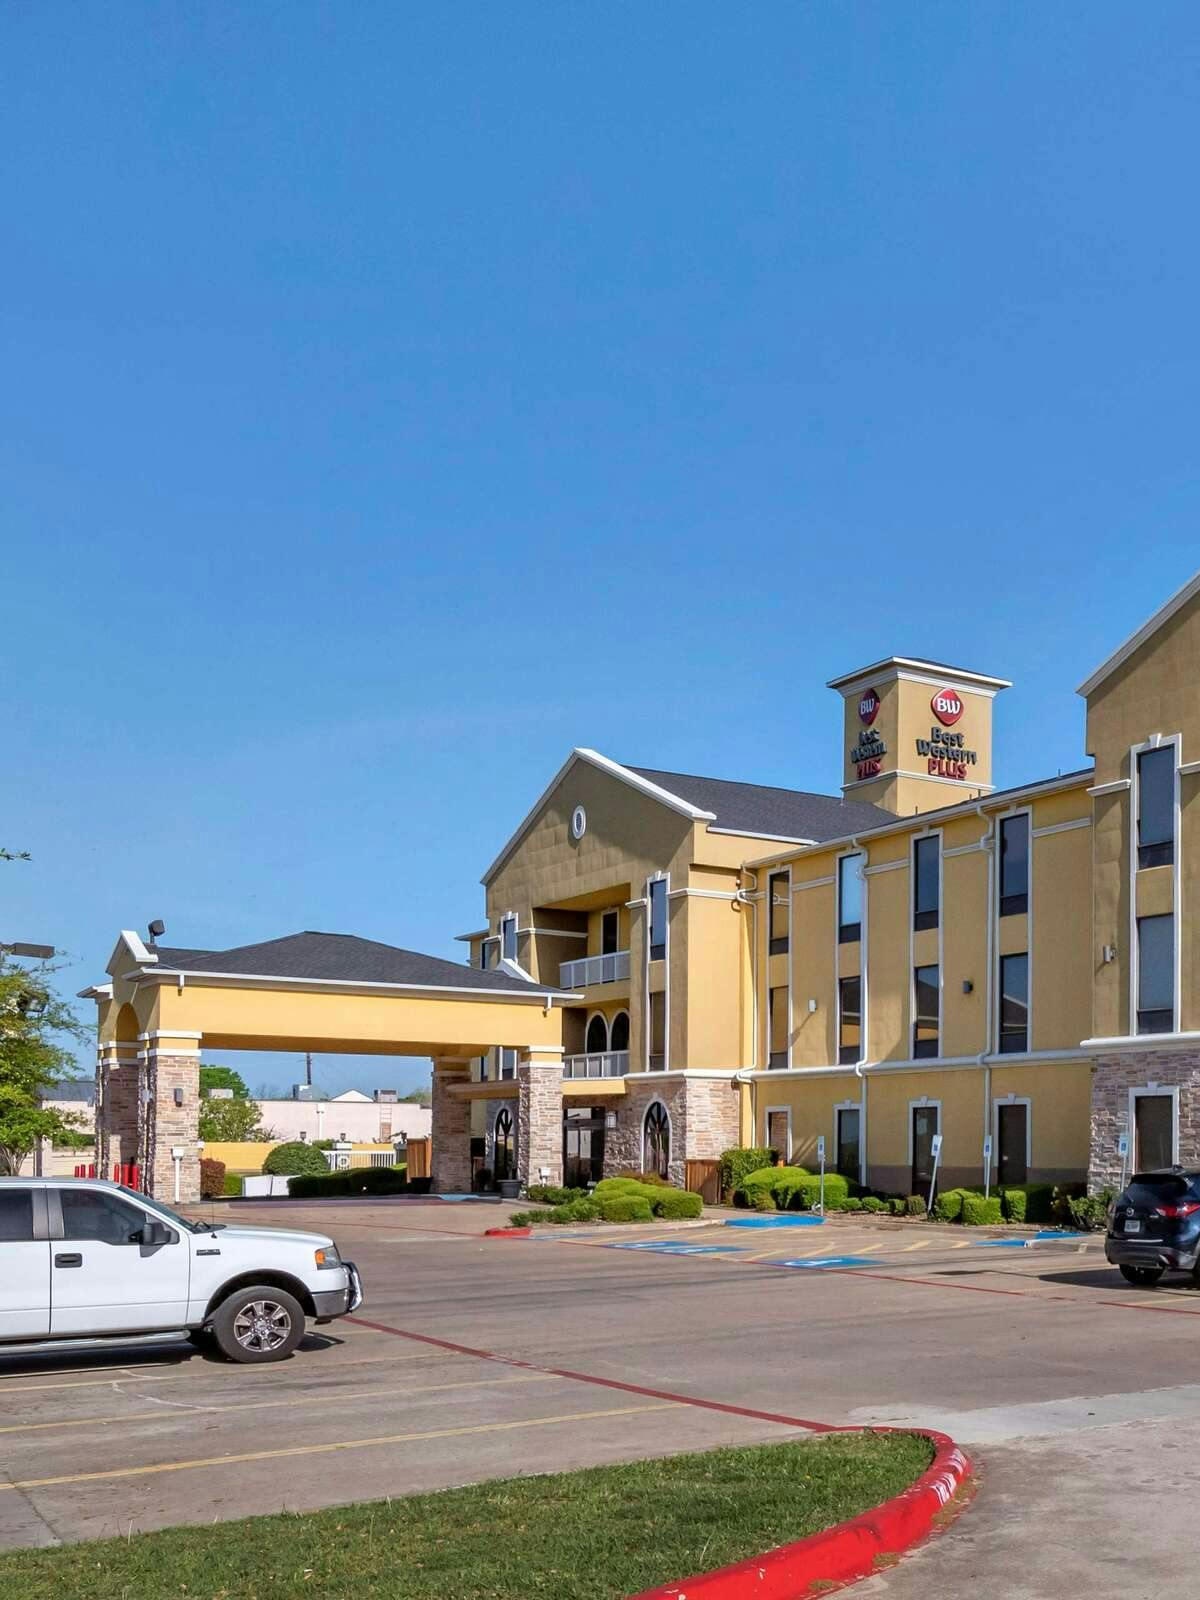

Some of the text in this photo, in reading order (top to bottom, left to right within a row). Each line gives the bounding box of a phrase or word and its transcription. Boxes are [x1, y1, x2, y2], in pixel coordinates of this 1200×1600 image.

[860, 699, 875, 715] BW
[936, 698, 960, 714] BW
[931, 727, 964, 748] Best
[916, 739, 977, 765] Western
[928, 758, 967, 780] PLUS
